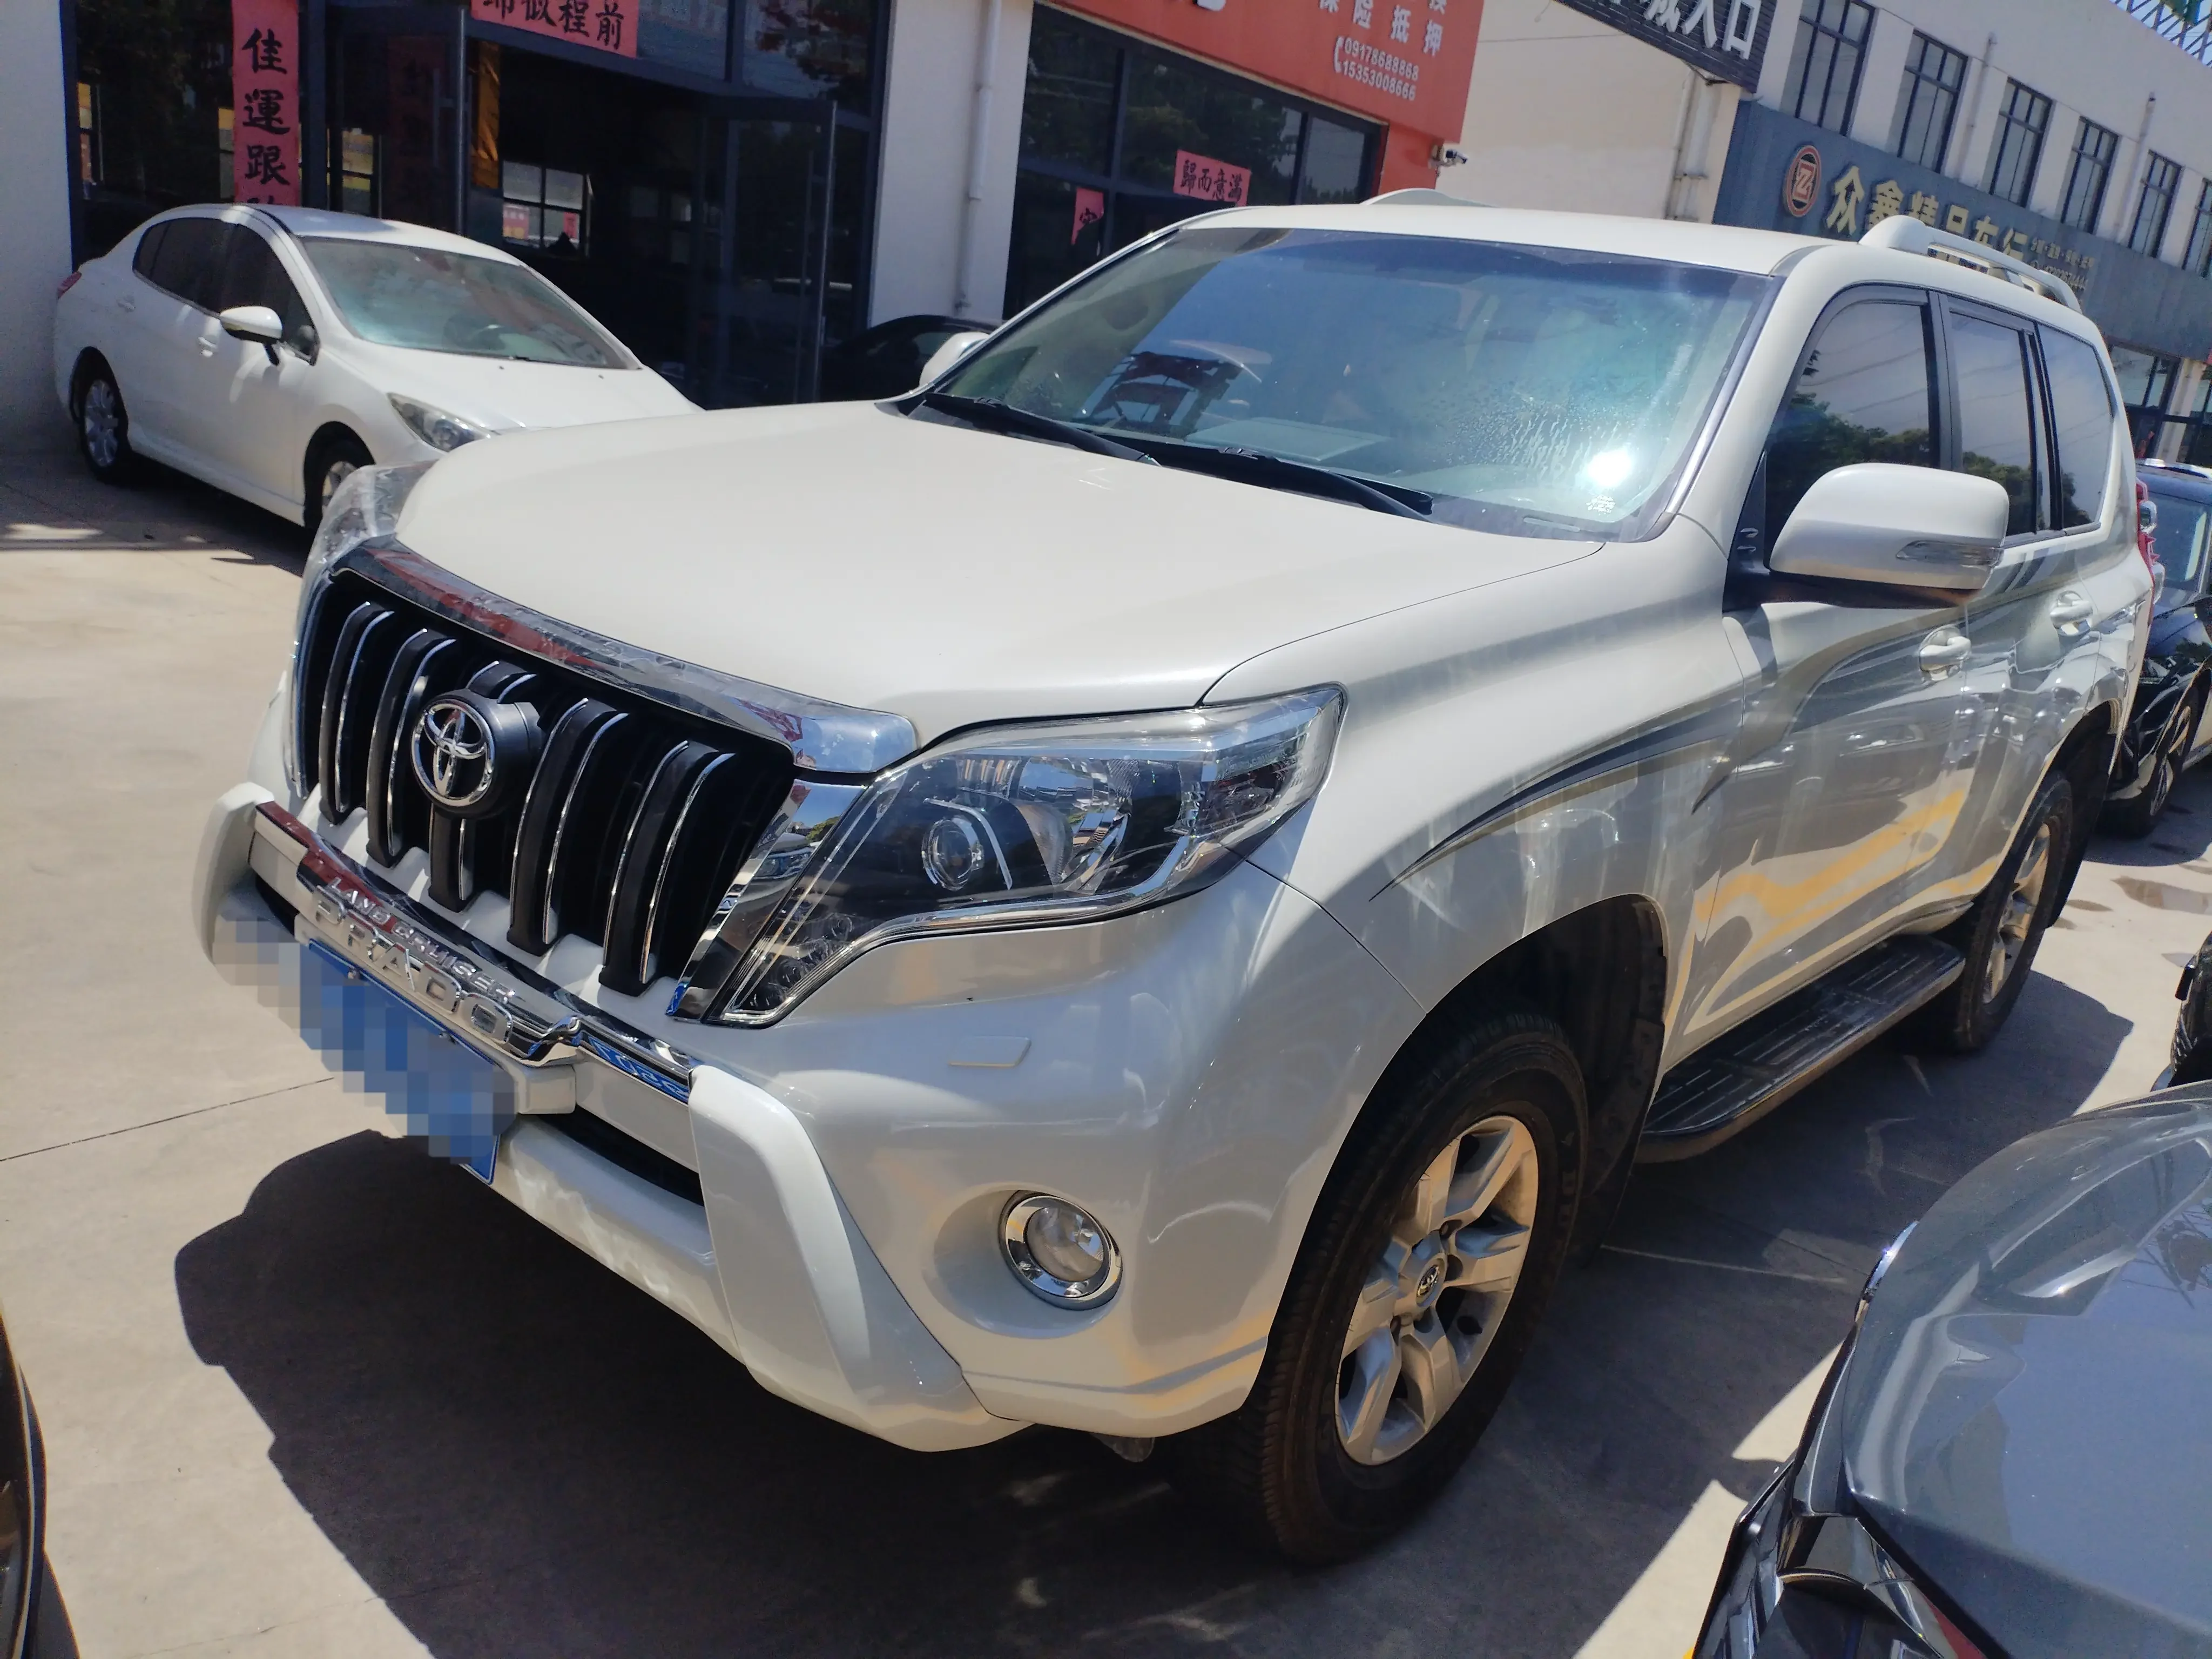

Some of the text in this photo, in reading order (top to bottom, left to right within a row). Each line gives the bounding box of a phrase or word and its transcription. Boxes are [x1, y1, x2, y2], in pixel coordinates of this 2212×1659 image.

[242, 28, 291, 205] 佳運跟
[315, 885, 514, 1044] PRADO
[326, 877, 516, 1005] LAND CRUISER
